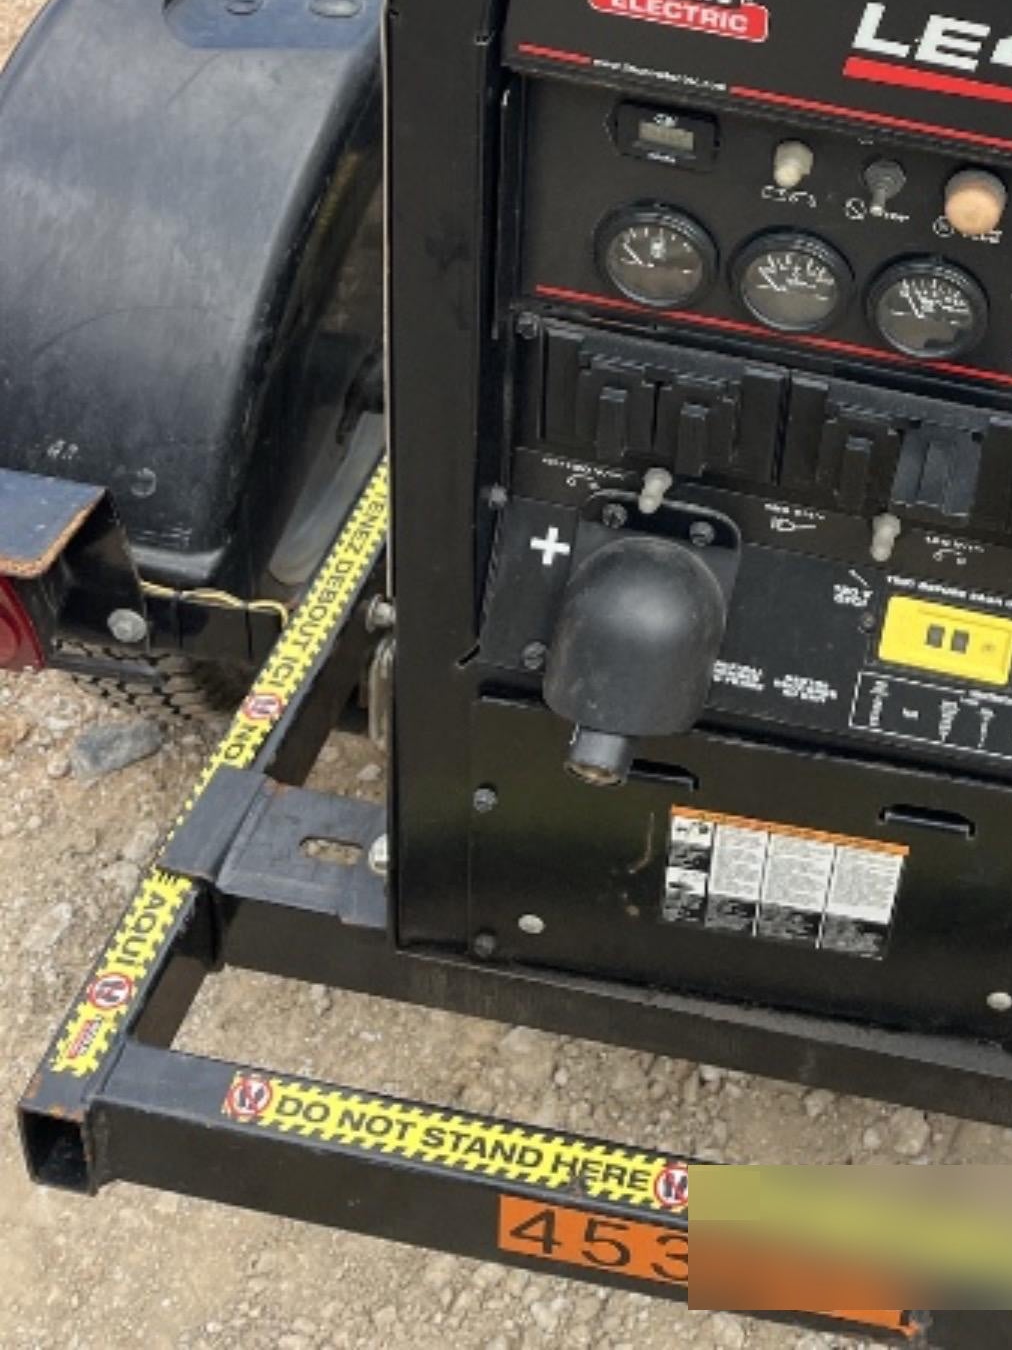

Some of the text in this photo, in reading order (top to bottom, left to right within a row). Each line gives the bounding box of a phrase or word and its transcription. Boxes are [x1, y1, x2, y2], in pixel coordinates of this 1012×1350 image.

[348, 488, 388, 554] ENEZ
[274, 1095, 650, 1192] DO NOT STAND HERE
